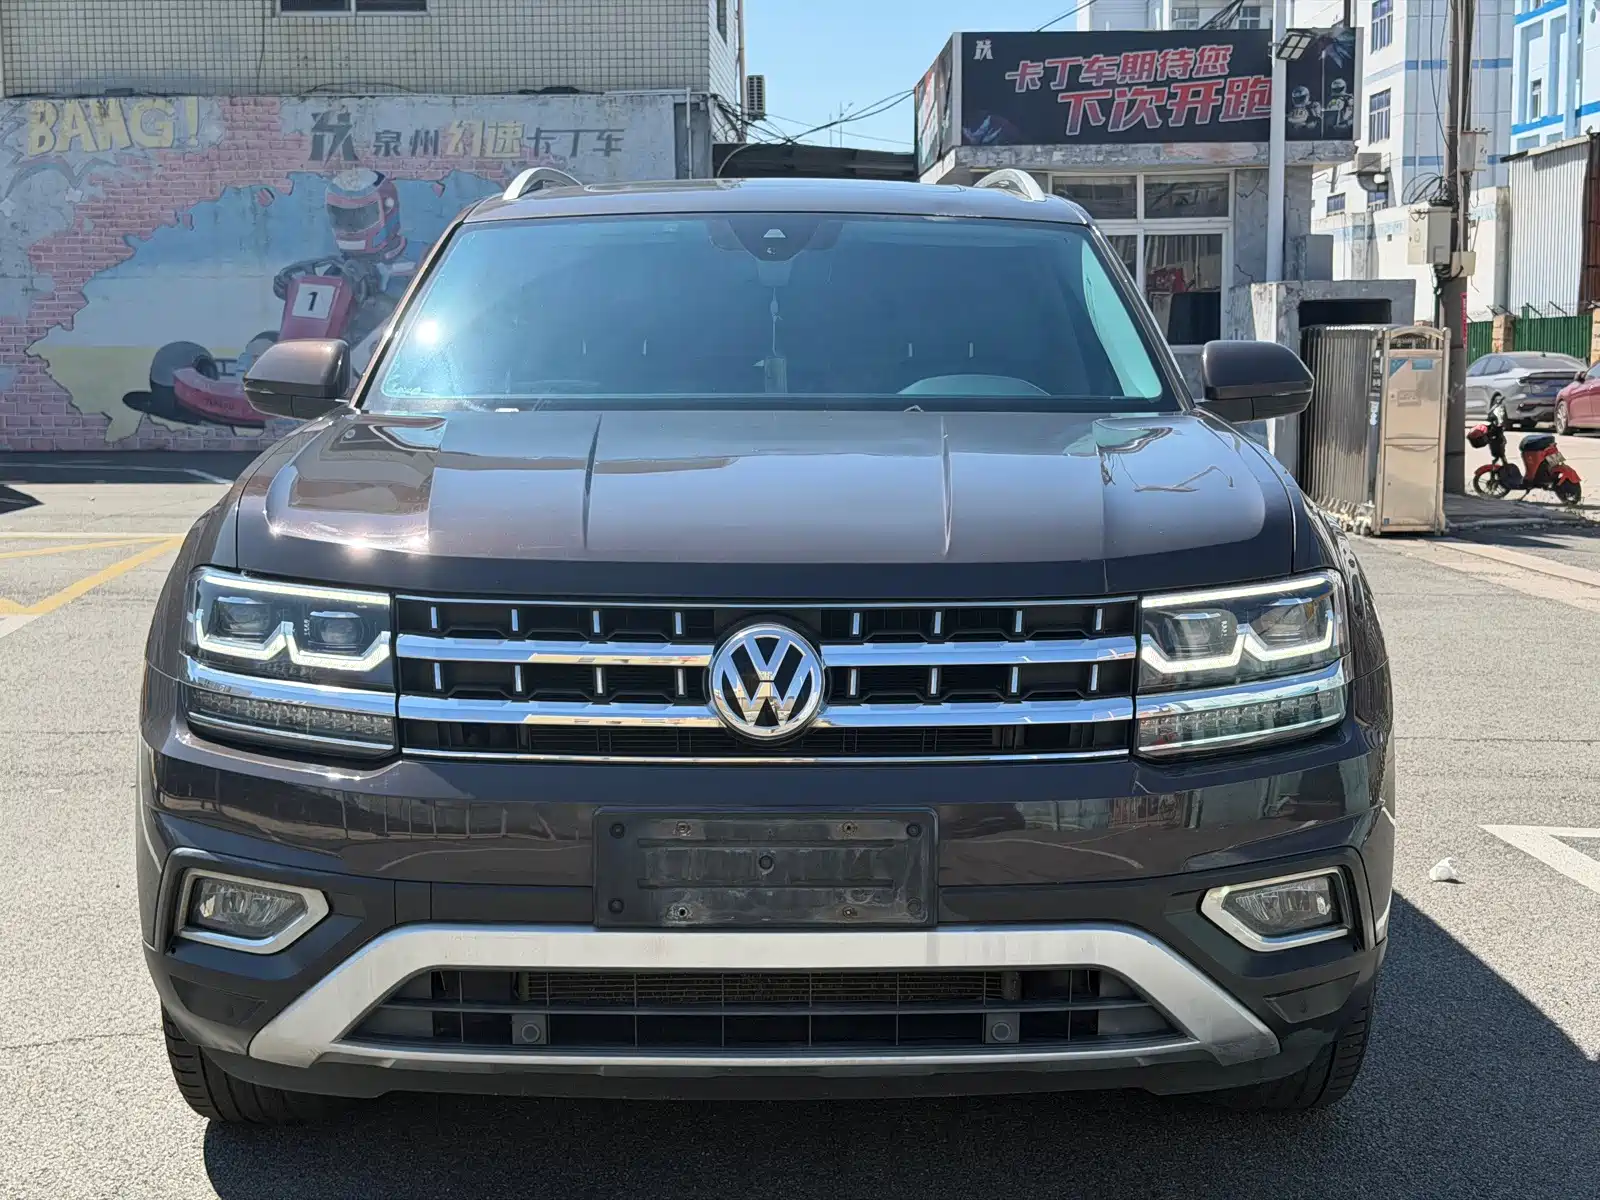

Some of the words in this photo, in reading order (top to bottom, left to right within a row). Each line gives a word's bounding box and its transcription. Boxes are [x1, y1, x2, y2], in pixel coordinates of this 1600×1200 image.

[1005, 45, 1233, 93] 卡丁车期待您
[1057, 75, 1271, 136] 下次开跑
[307, 291, 319, 312] 1
